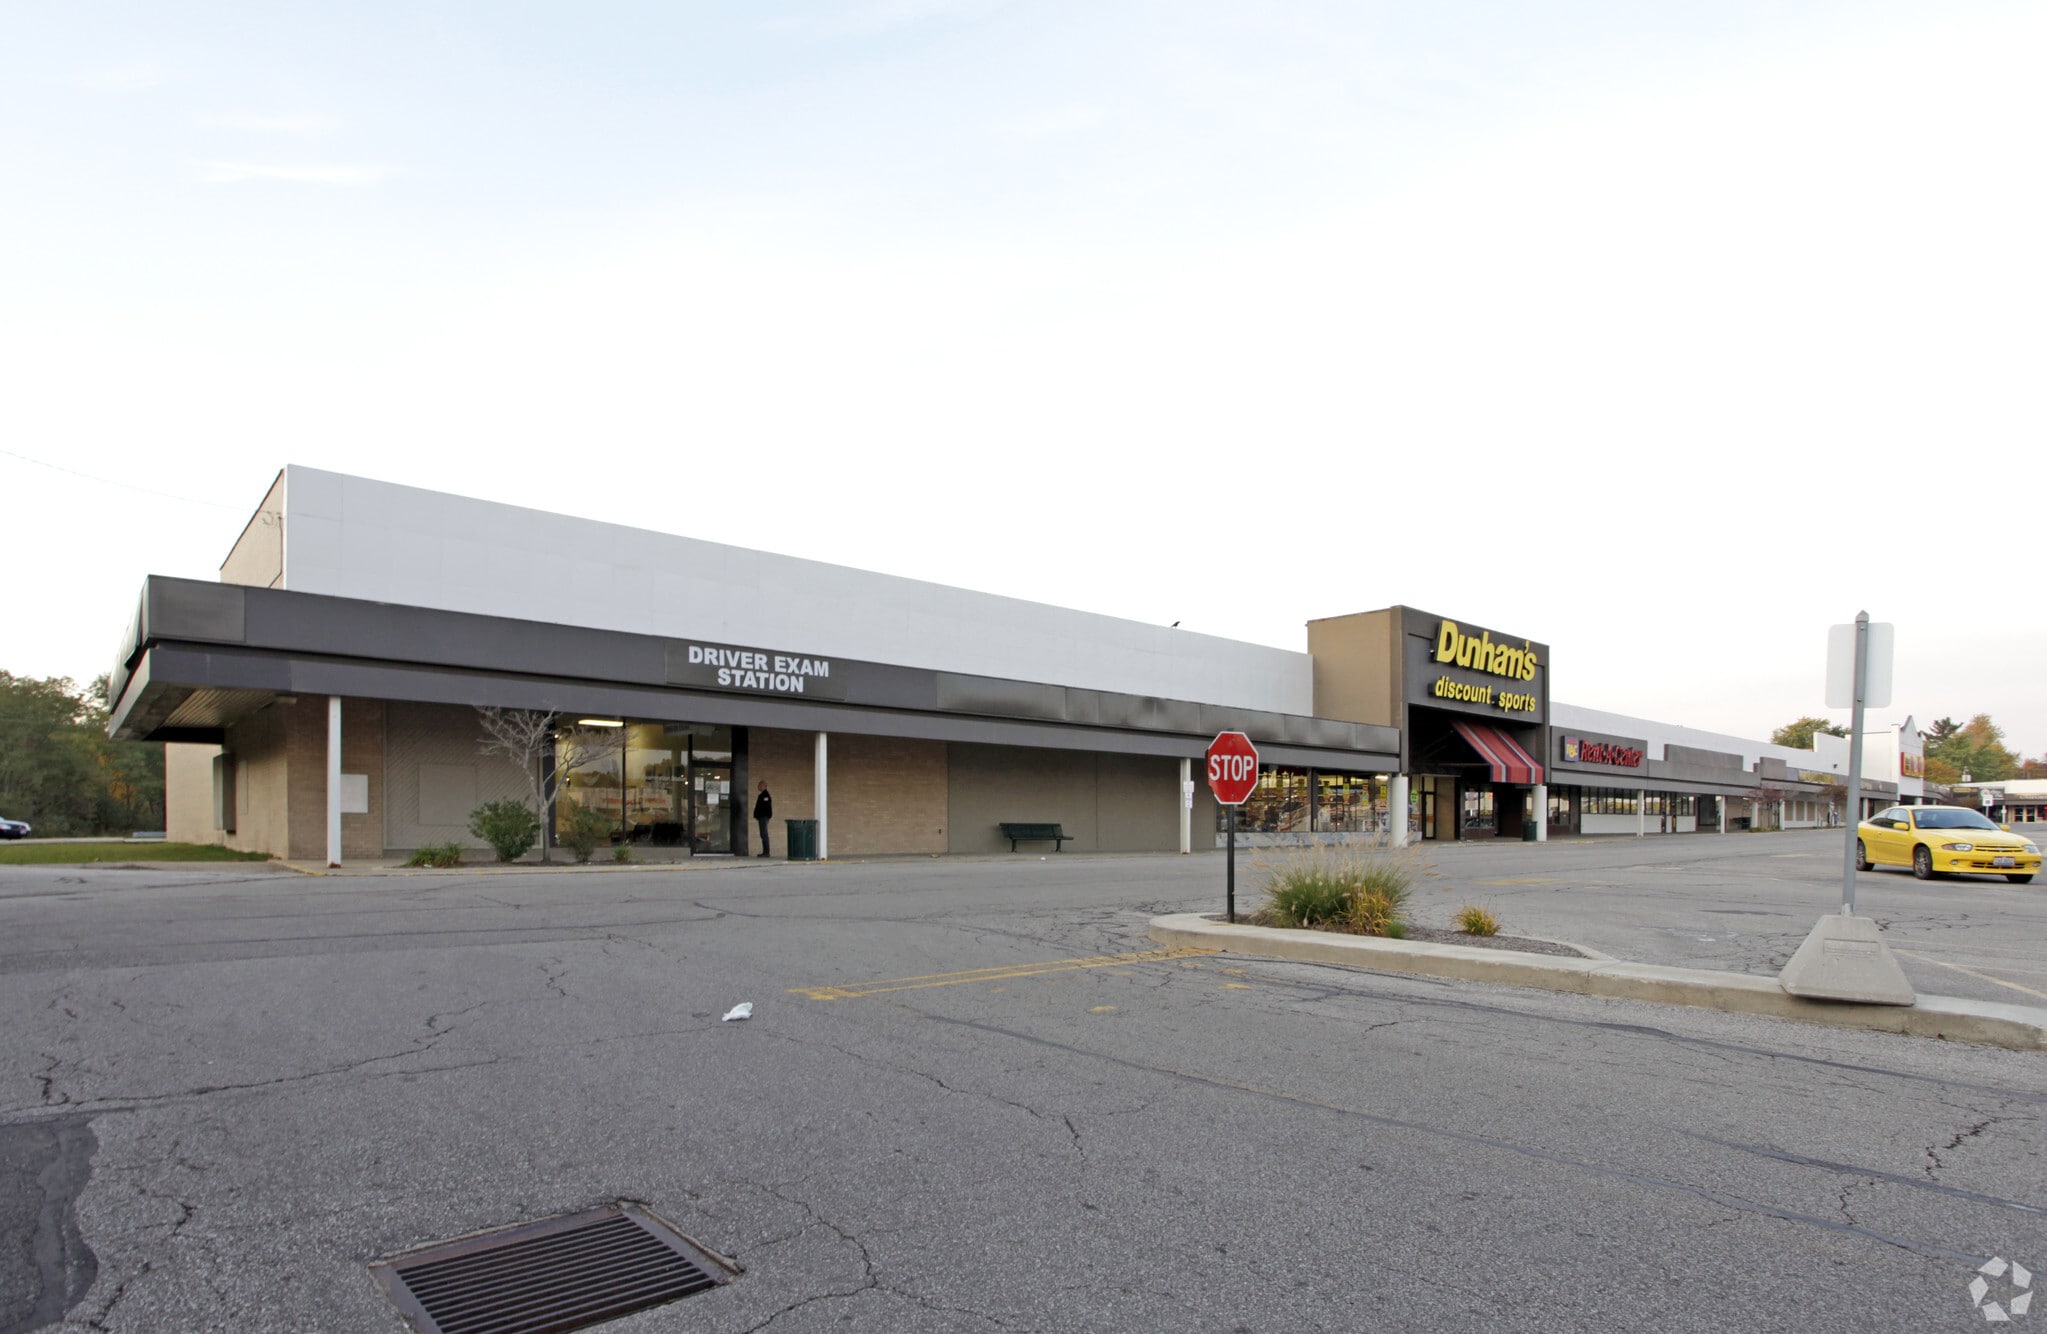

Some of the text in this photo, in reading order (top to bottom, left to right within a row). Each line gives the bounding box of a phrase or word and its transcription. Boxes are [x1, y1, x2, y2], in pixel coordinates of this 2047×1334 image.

[689, 646, 829, 677] DRIVER EXAM
[1436, 620, 1537, 681] Dunham's
[717, 668, 804, 693] STATION
[1435, 676, 1536, 712] discount sports
[1209, 754, 1254, 781] STOP
